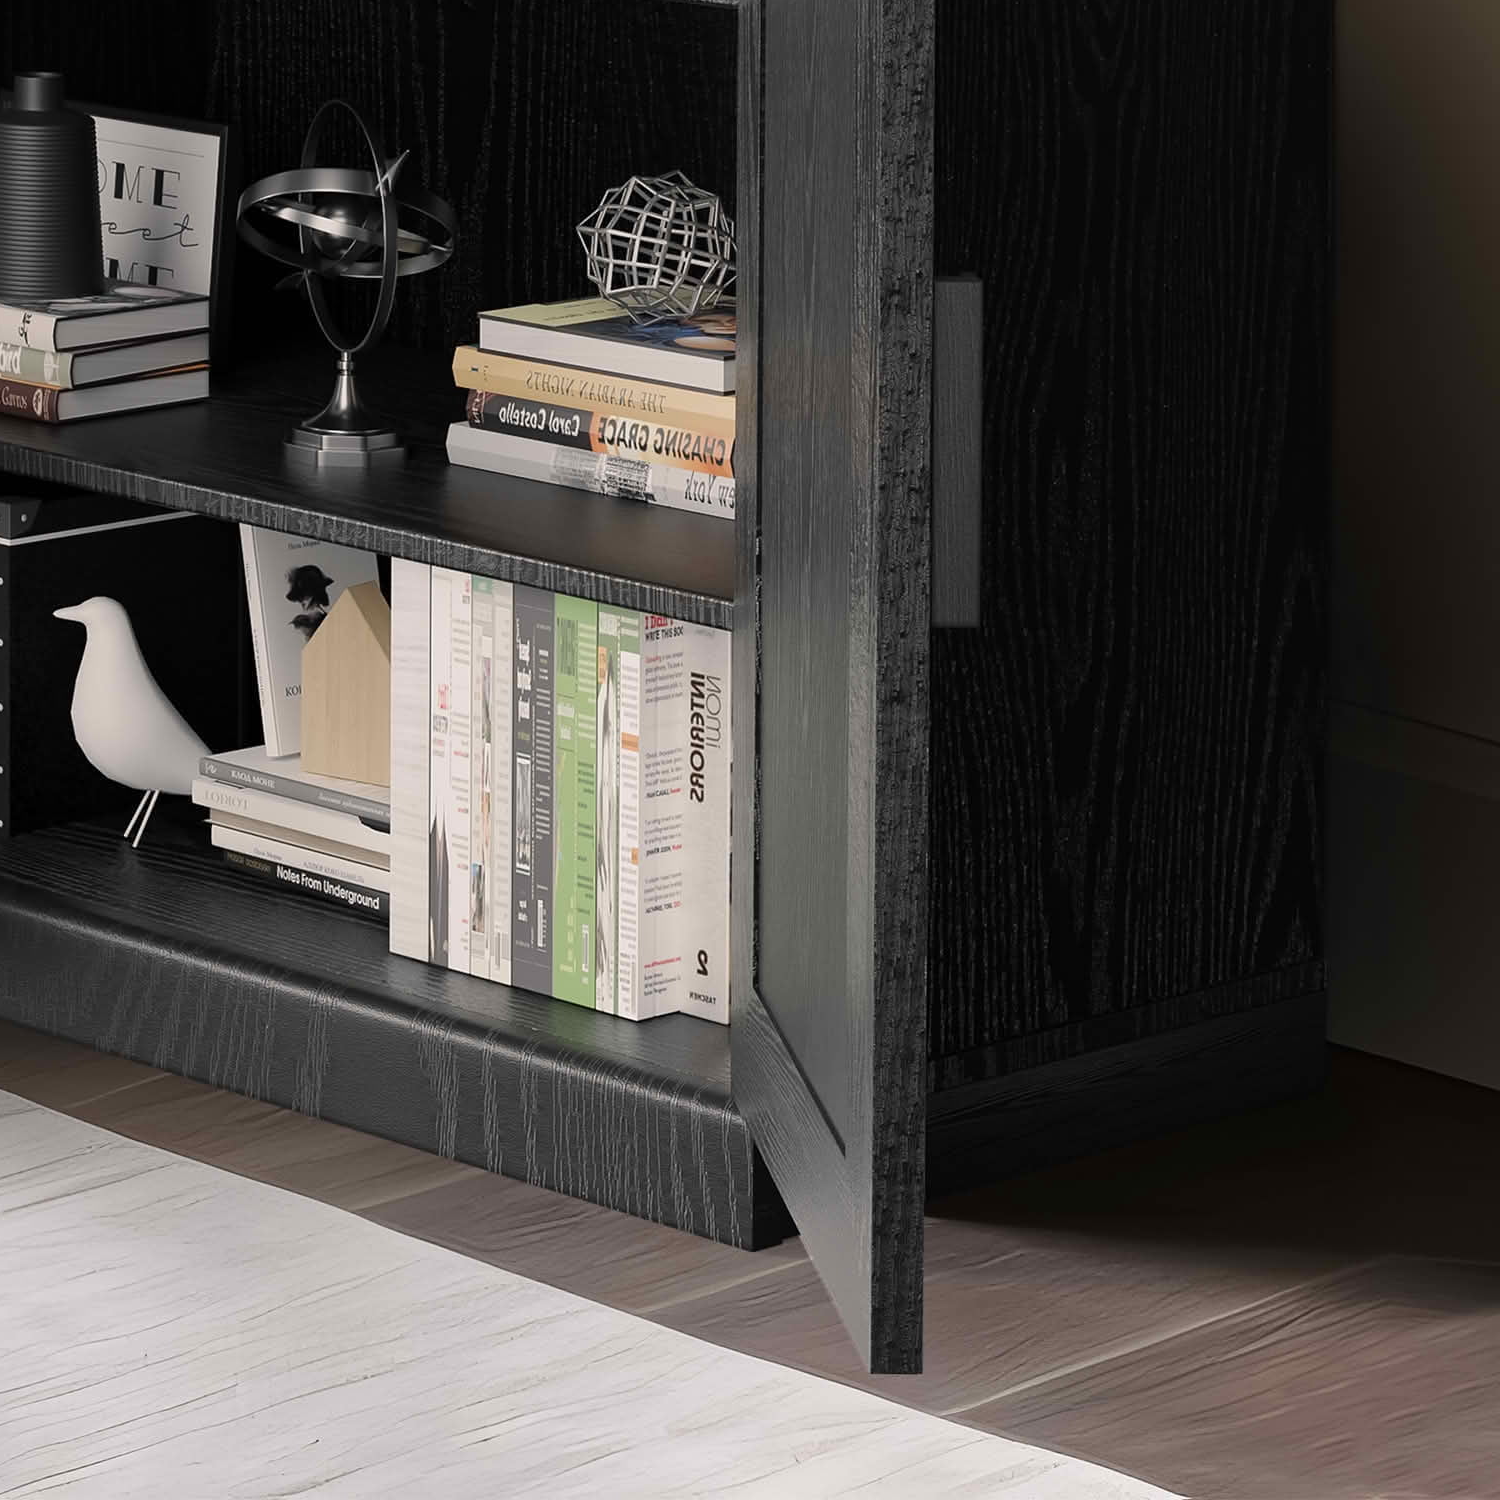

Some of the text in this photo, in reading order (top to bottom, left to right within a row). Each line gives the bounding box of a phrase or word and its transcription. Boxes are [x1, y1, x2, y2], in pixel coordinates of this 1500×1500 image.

[276, 864, 301, 885] Notes
[301, 872, 323, 892] From
[323, 879, 380, 911] Underground
